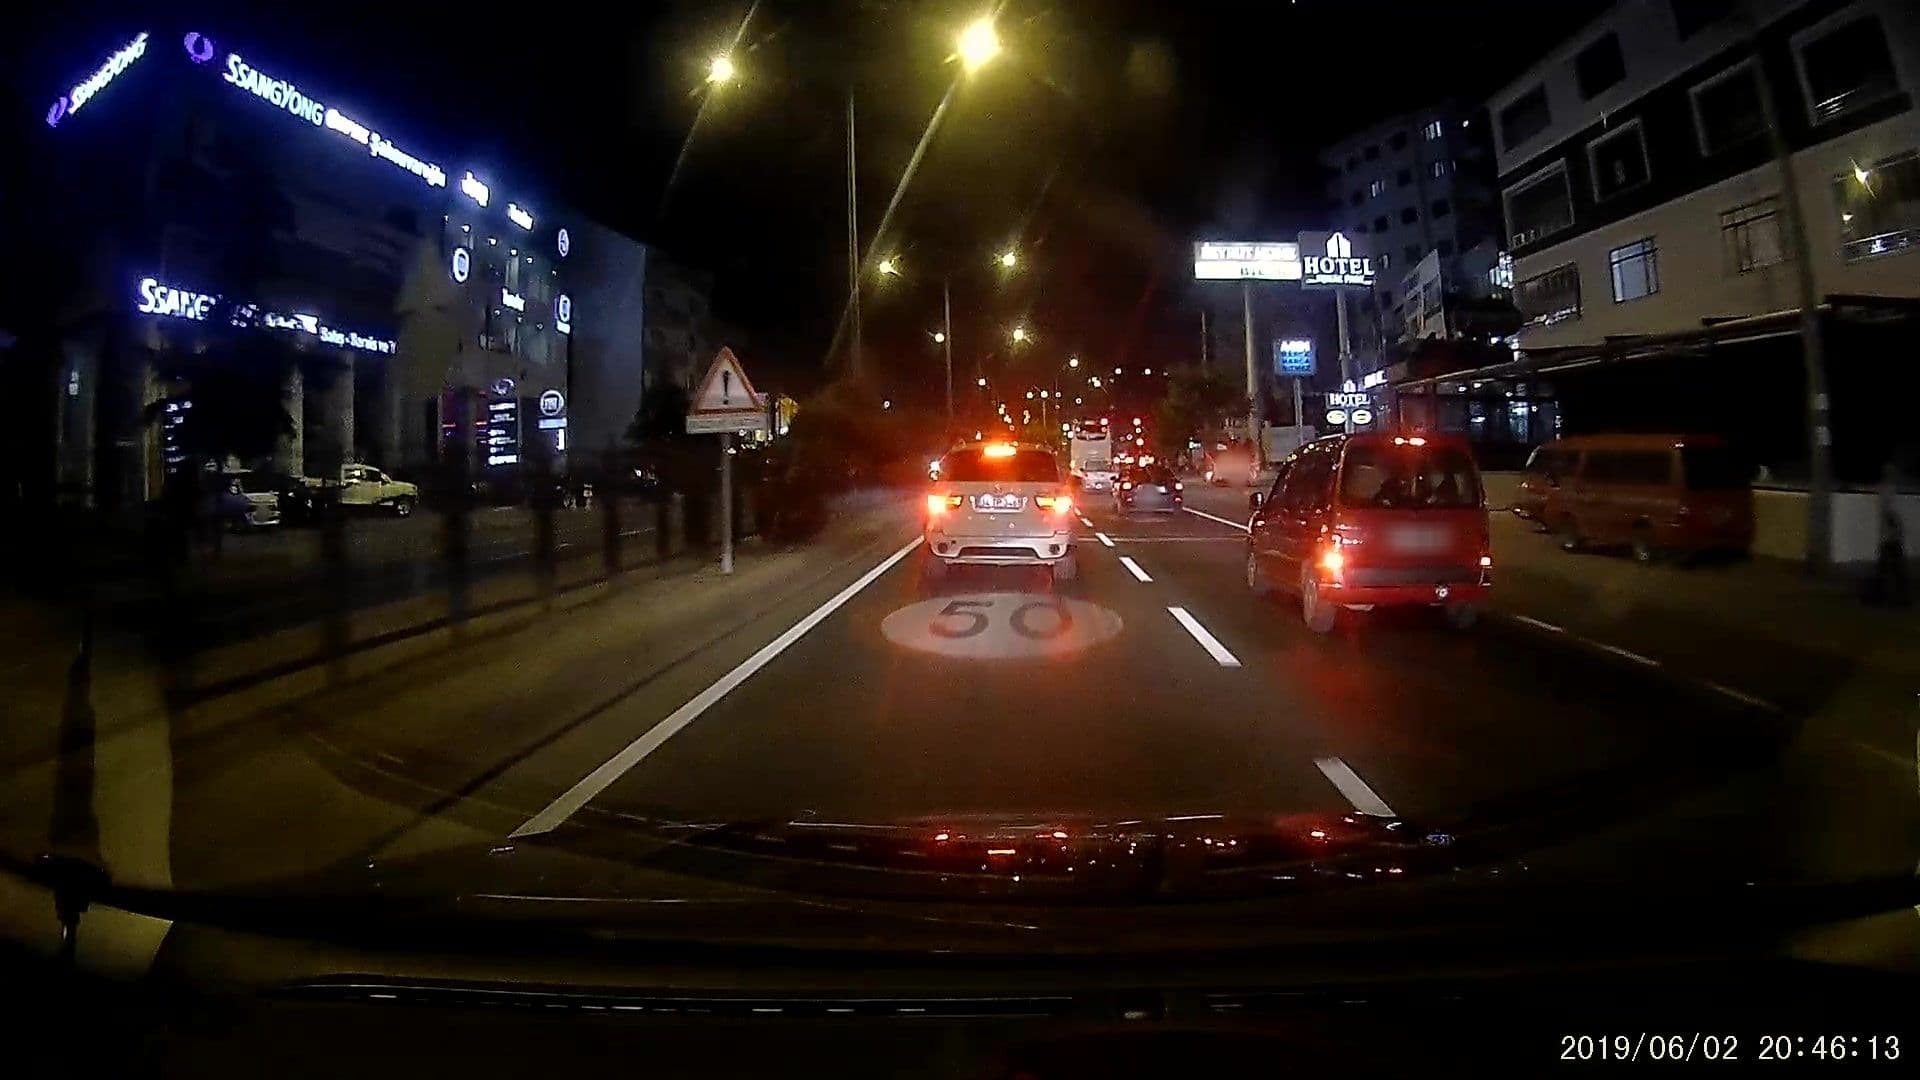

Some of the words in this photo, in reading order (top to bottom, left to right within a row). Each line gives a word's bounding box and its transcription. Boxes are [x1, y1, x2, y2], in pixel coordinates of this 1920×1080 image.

[222, 53, 324, 126] SSANGYONG
[1303, 256, 1375, 276] HOTEL
[1329, 392, 1371, 407] HOTEL
[929, 600, 1072, 640] 50
